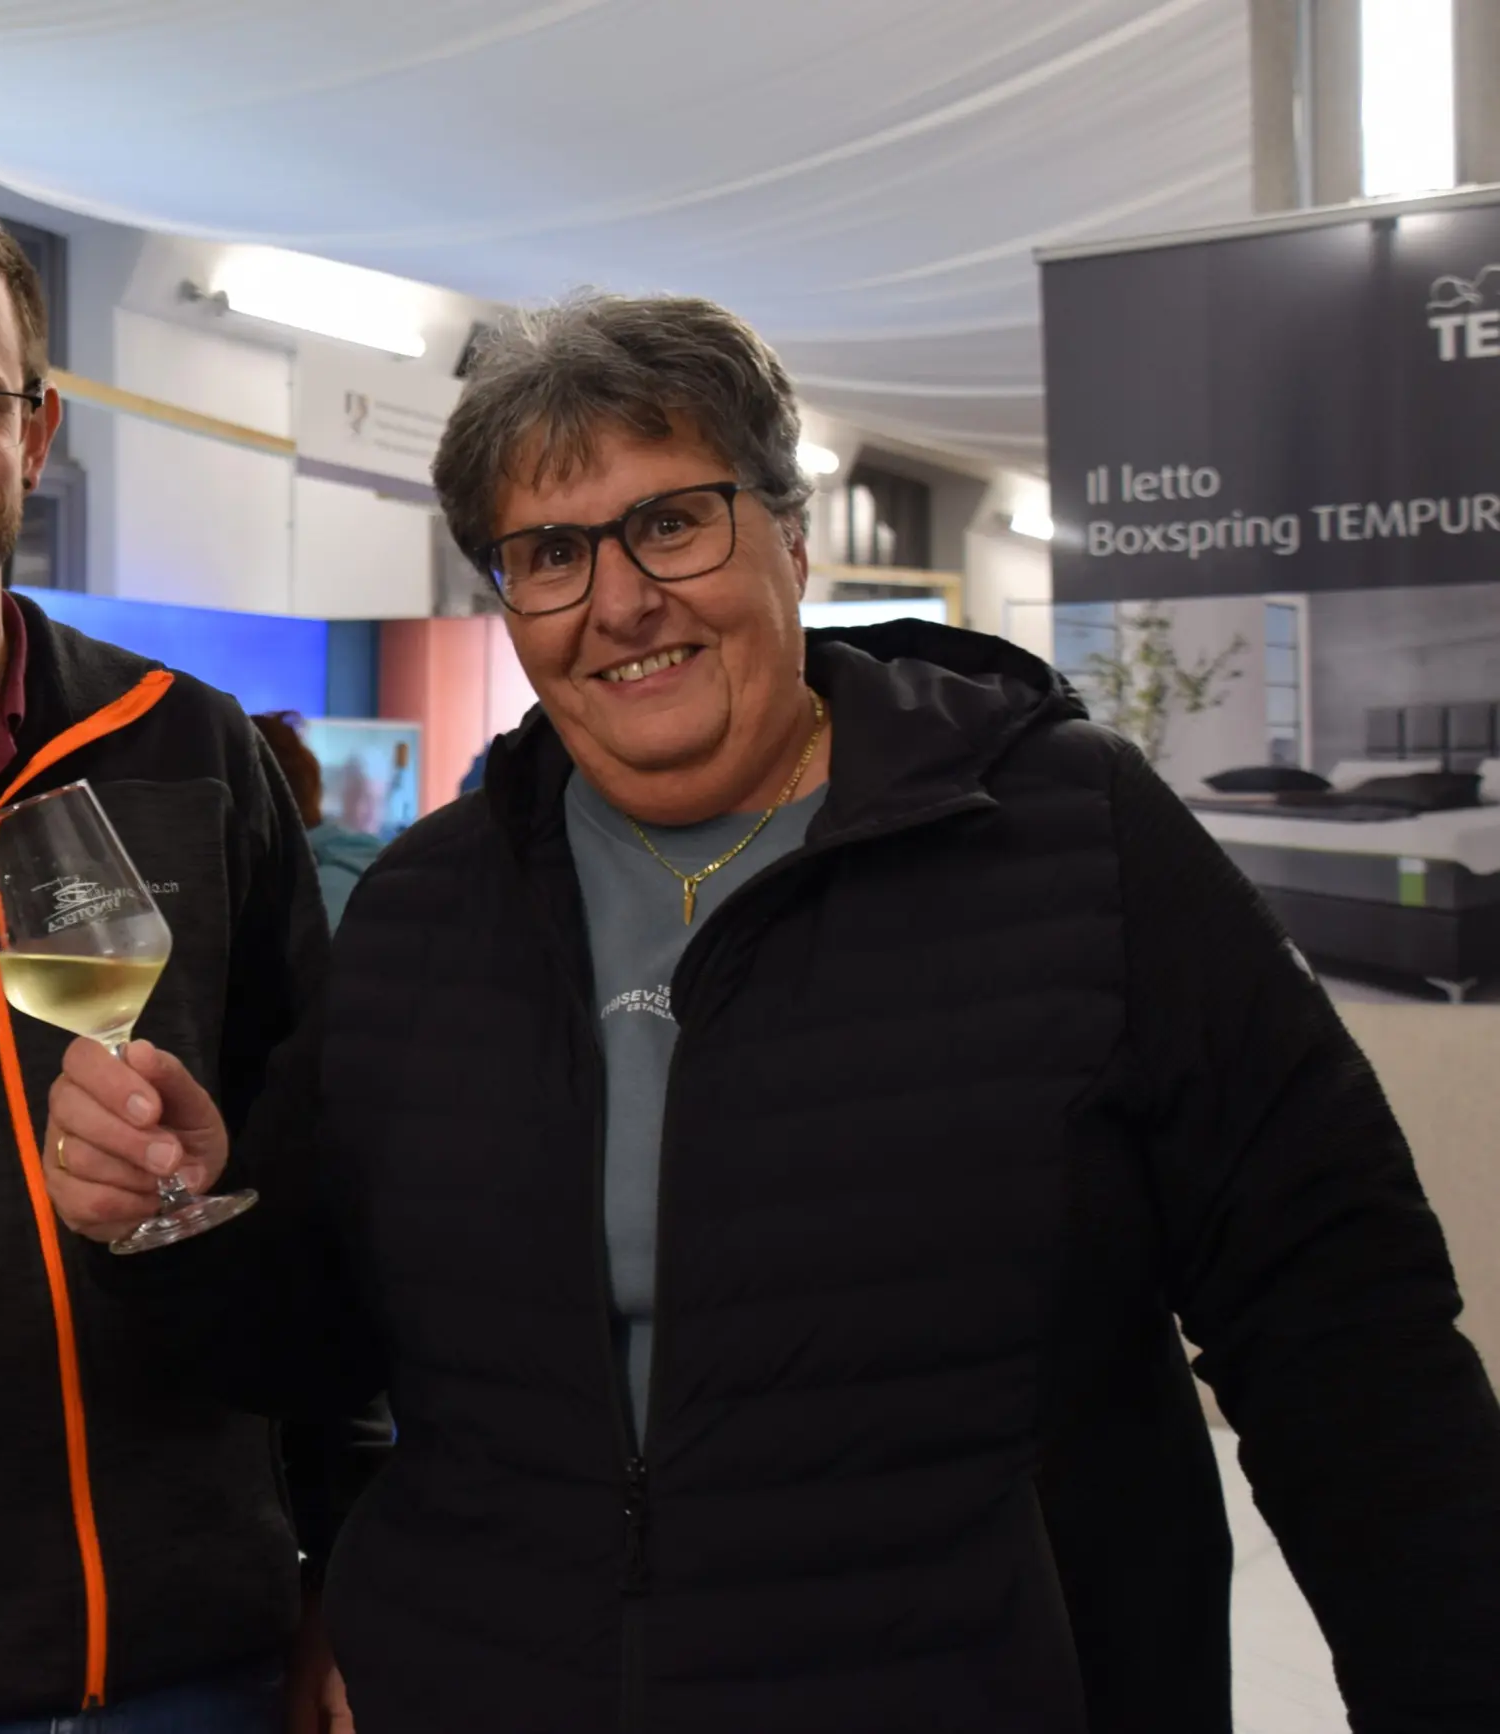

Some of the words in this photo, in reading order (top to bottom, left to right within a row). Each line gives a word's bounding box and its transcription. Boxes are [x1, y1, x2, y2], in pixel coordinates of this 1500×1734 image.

[1428, 310, 1500, 362] TE
[1087, 466, 1109, 504] Il
[1121, 464, 1221, 502] letto
[1087, 509, 1300, 560] Boxspring
[1309, 493, 1500, 542] TEMPUR
